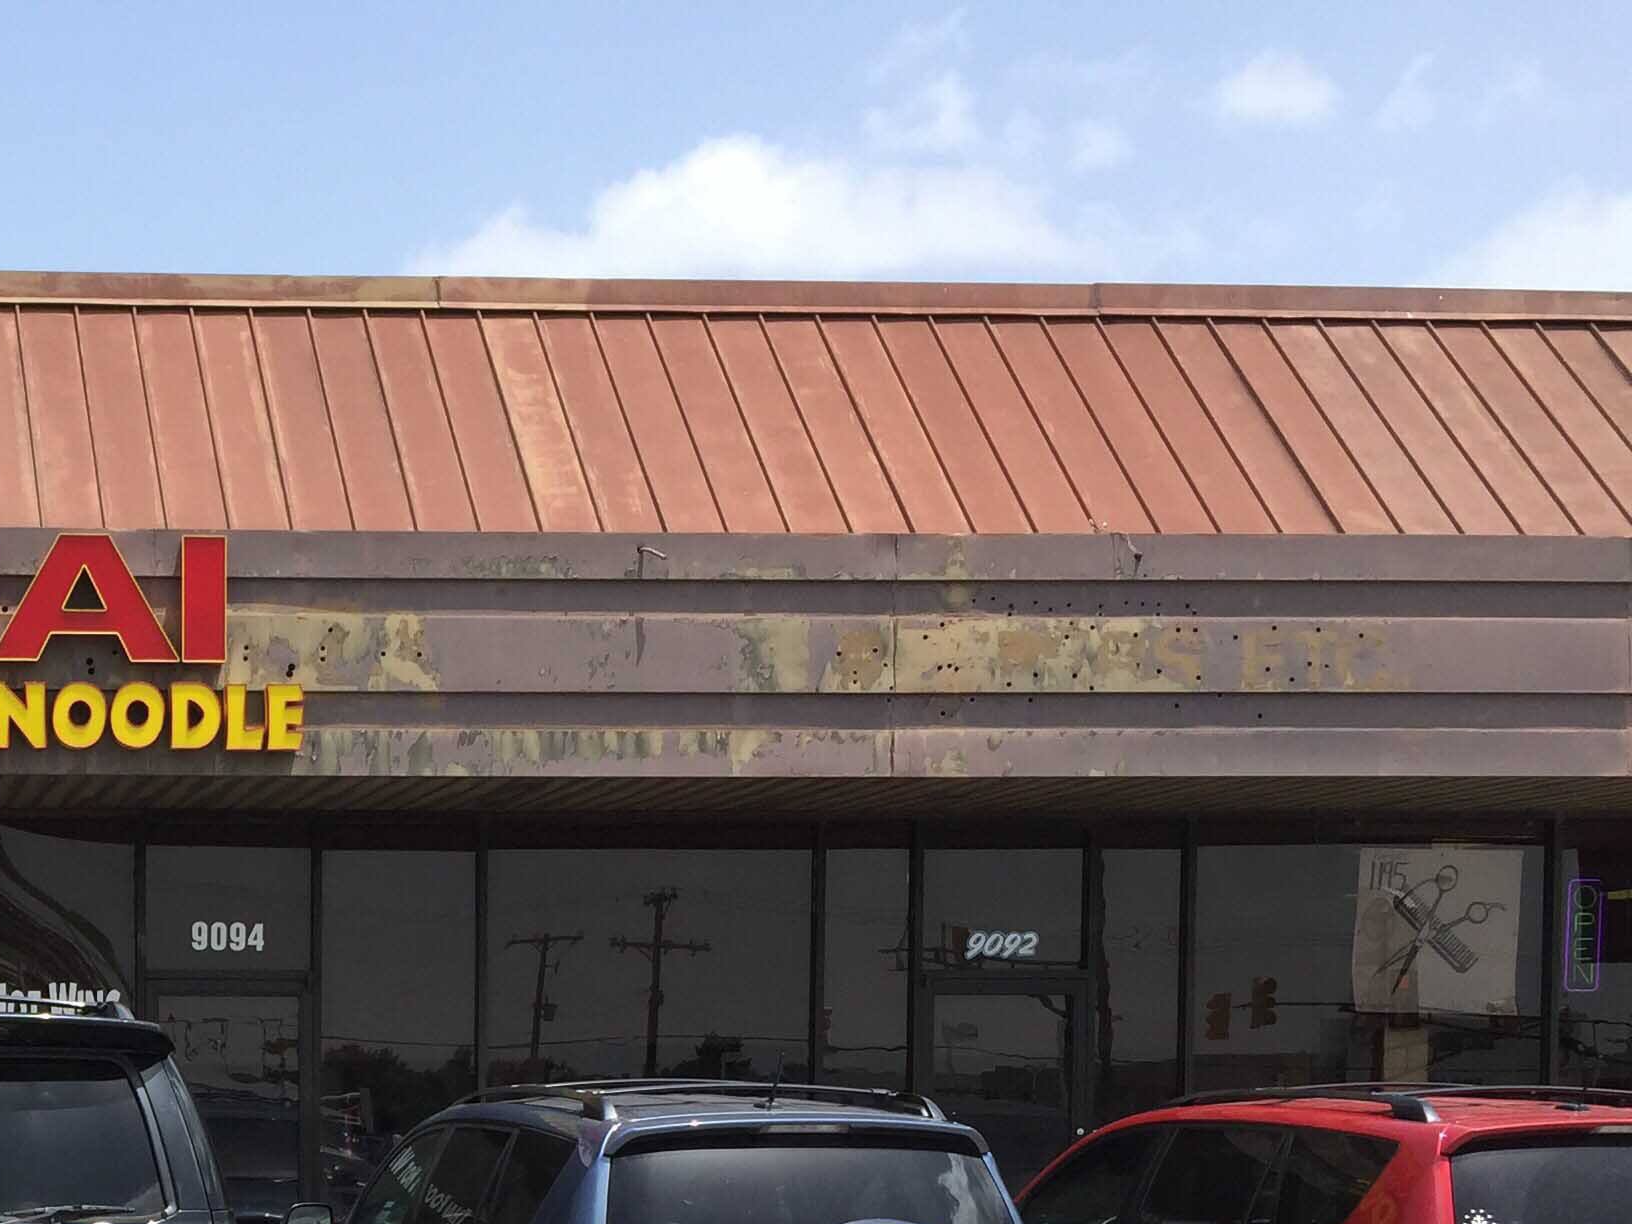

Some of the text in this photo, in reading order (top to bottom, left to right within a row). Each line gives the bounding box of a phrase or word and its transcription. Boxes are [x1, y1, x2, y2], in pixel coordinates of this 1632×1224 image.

[190, 921, 265, 952] 9094
[964, 930, 1040, 960] 9092
[1573, 884, 1598, 985] OPEN
